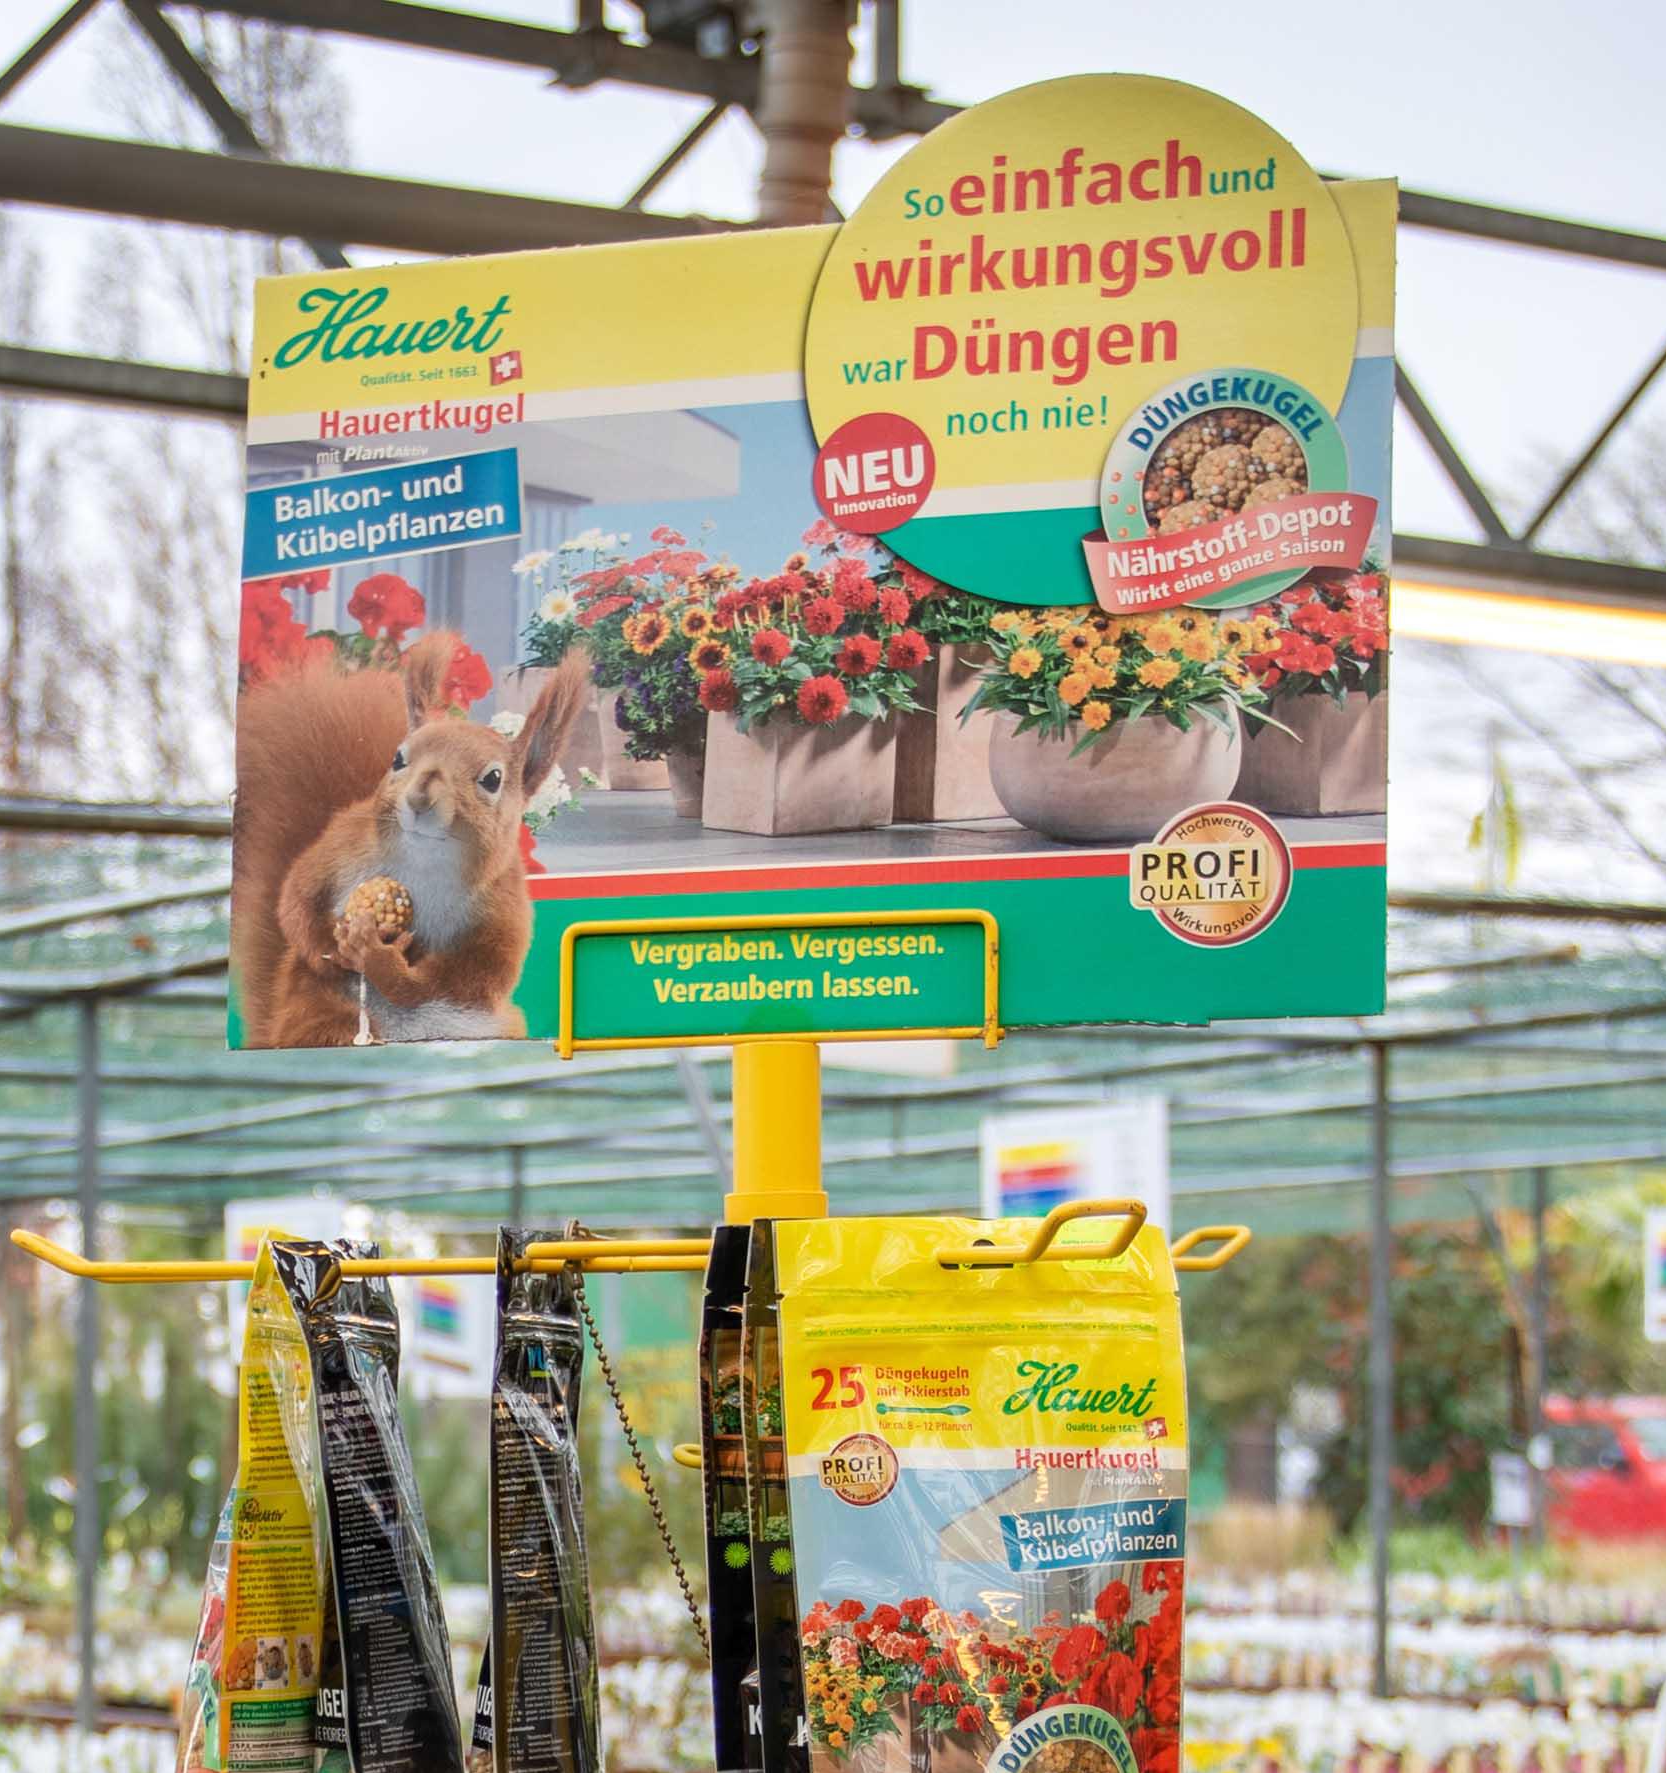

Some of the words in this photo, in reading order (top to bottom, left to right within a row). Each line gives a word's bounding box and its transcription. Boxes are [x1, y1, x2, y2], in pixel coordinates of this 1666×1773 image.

[904, 188, 944, 220] So
[949, 139, 1203, 217] einfach
[1209, 158, 1276, 195] und
[853, 207, 1307, 301] wirkungsvoll
[273, 287, 513, 369] Hauert
[843, 356, 908, 385] war
[912, 317, 1178, 386] Düngen
[419, 369, 444, 382] Seit
[319, 393, 525, 440] Hauertkugel
[946, 400, 1030, 436] noch
[1042, 396, 1109, 430] nie!
[1127, 376, 1325, 453] DÜNGEKUGEL
[316, 449, 340, 465] mit
[824, 443, 926, 499] NEU
[275, 487, 393, 523] Balkon-
[402, 465, 463, 501] und
[832, 491, 918, 517] Innovation
[276, 503, 505, 560] Kübelpflanzen
[1106, 500, 1353, 579] Nährstoff-Depot
[1116, 582, 1171, 608] Wirkt
[1175, 571, 1215, 594] eine
[1218, 551, 1275, 584] ganze
[1278, 537, 1346, 559] Saison
[1175, 815, 1255, 841] Hochwertig
[1141, 849, 1259, 881] PROFI
[1140, 879, 1261, 904] QUALITÄT
[1172, 903, 1261, 936] Wirkungsvoll
[631, 935, 783, 970] Vergraben.
[790, 932, 945, 964] Vergessen.
[653, 974, 813, 1004] Verzaubern
[823, 971, 920, 998] lassen.
[811, 1366, 866, 1411] 25
[876, 1366, 970, 1382] Düngekugeln
[877, 1385, 898, 1397] mit
[904, 1384, 970, 1397] Pikierstab
[1002, 1360, 1157, 1417] Hauert
[823, 1457, 883, 1476] PROFI
[824, 1471, 884, 1486] QUALITÄT
[1015, 1447, 1159, 1473] Hauertkugel
[1016, 1514, 1106, 1540] Balkon-
[1114, 1504, 1155, 1527] und
[1020, 1532, 1177, 1563] Kübelpflanzen
